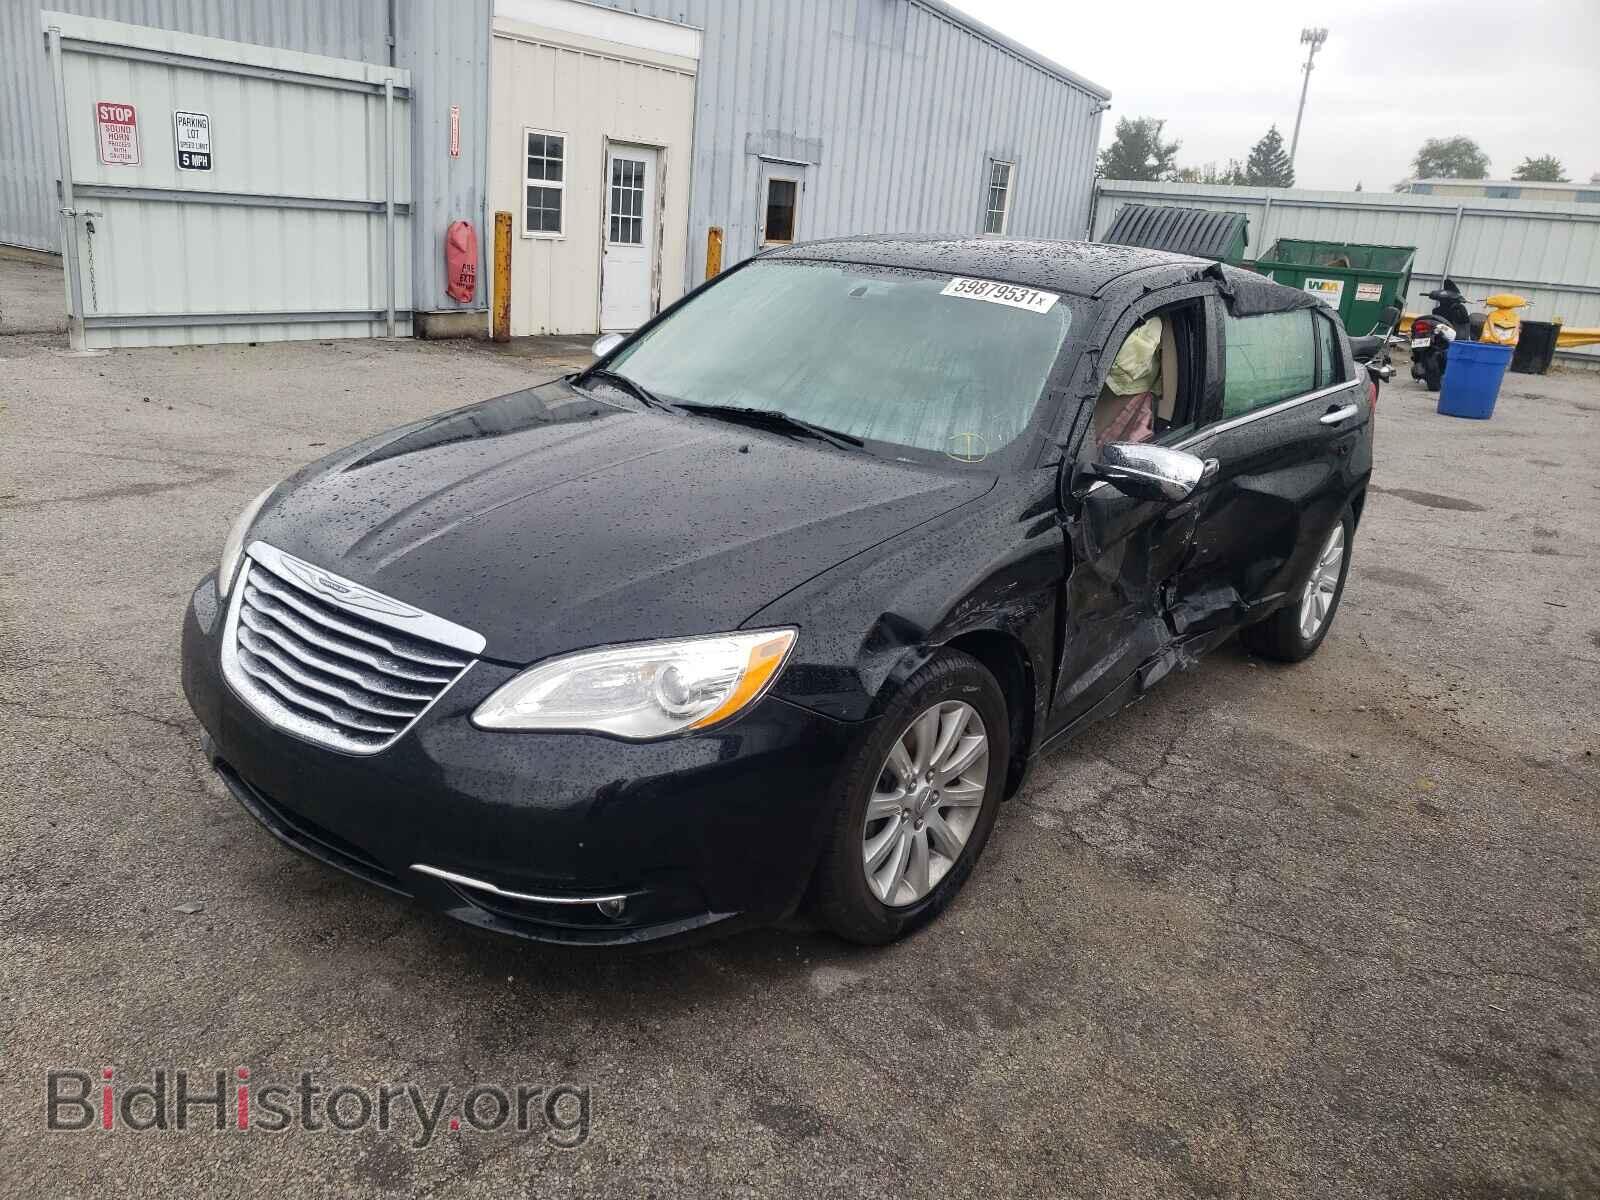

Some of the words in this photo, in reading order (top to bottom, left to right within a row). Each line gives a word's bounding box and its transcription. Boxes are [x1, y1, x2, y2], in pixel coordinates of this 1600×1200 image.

[100, 107, 132, 121] STOP
[178, 116, 207, 129] PARKING
[105, 124, 131, 134] SOUND
[187, 129, 200, 139] LOT
[108, 133, 130, 141] HORN
[182, 153, 189, 166] 5
[191, 154, 208, 167] MPH
[1309, 281, 1337, 291] WM
